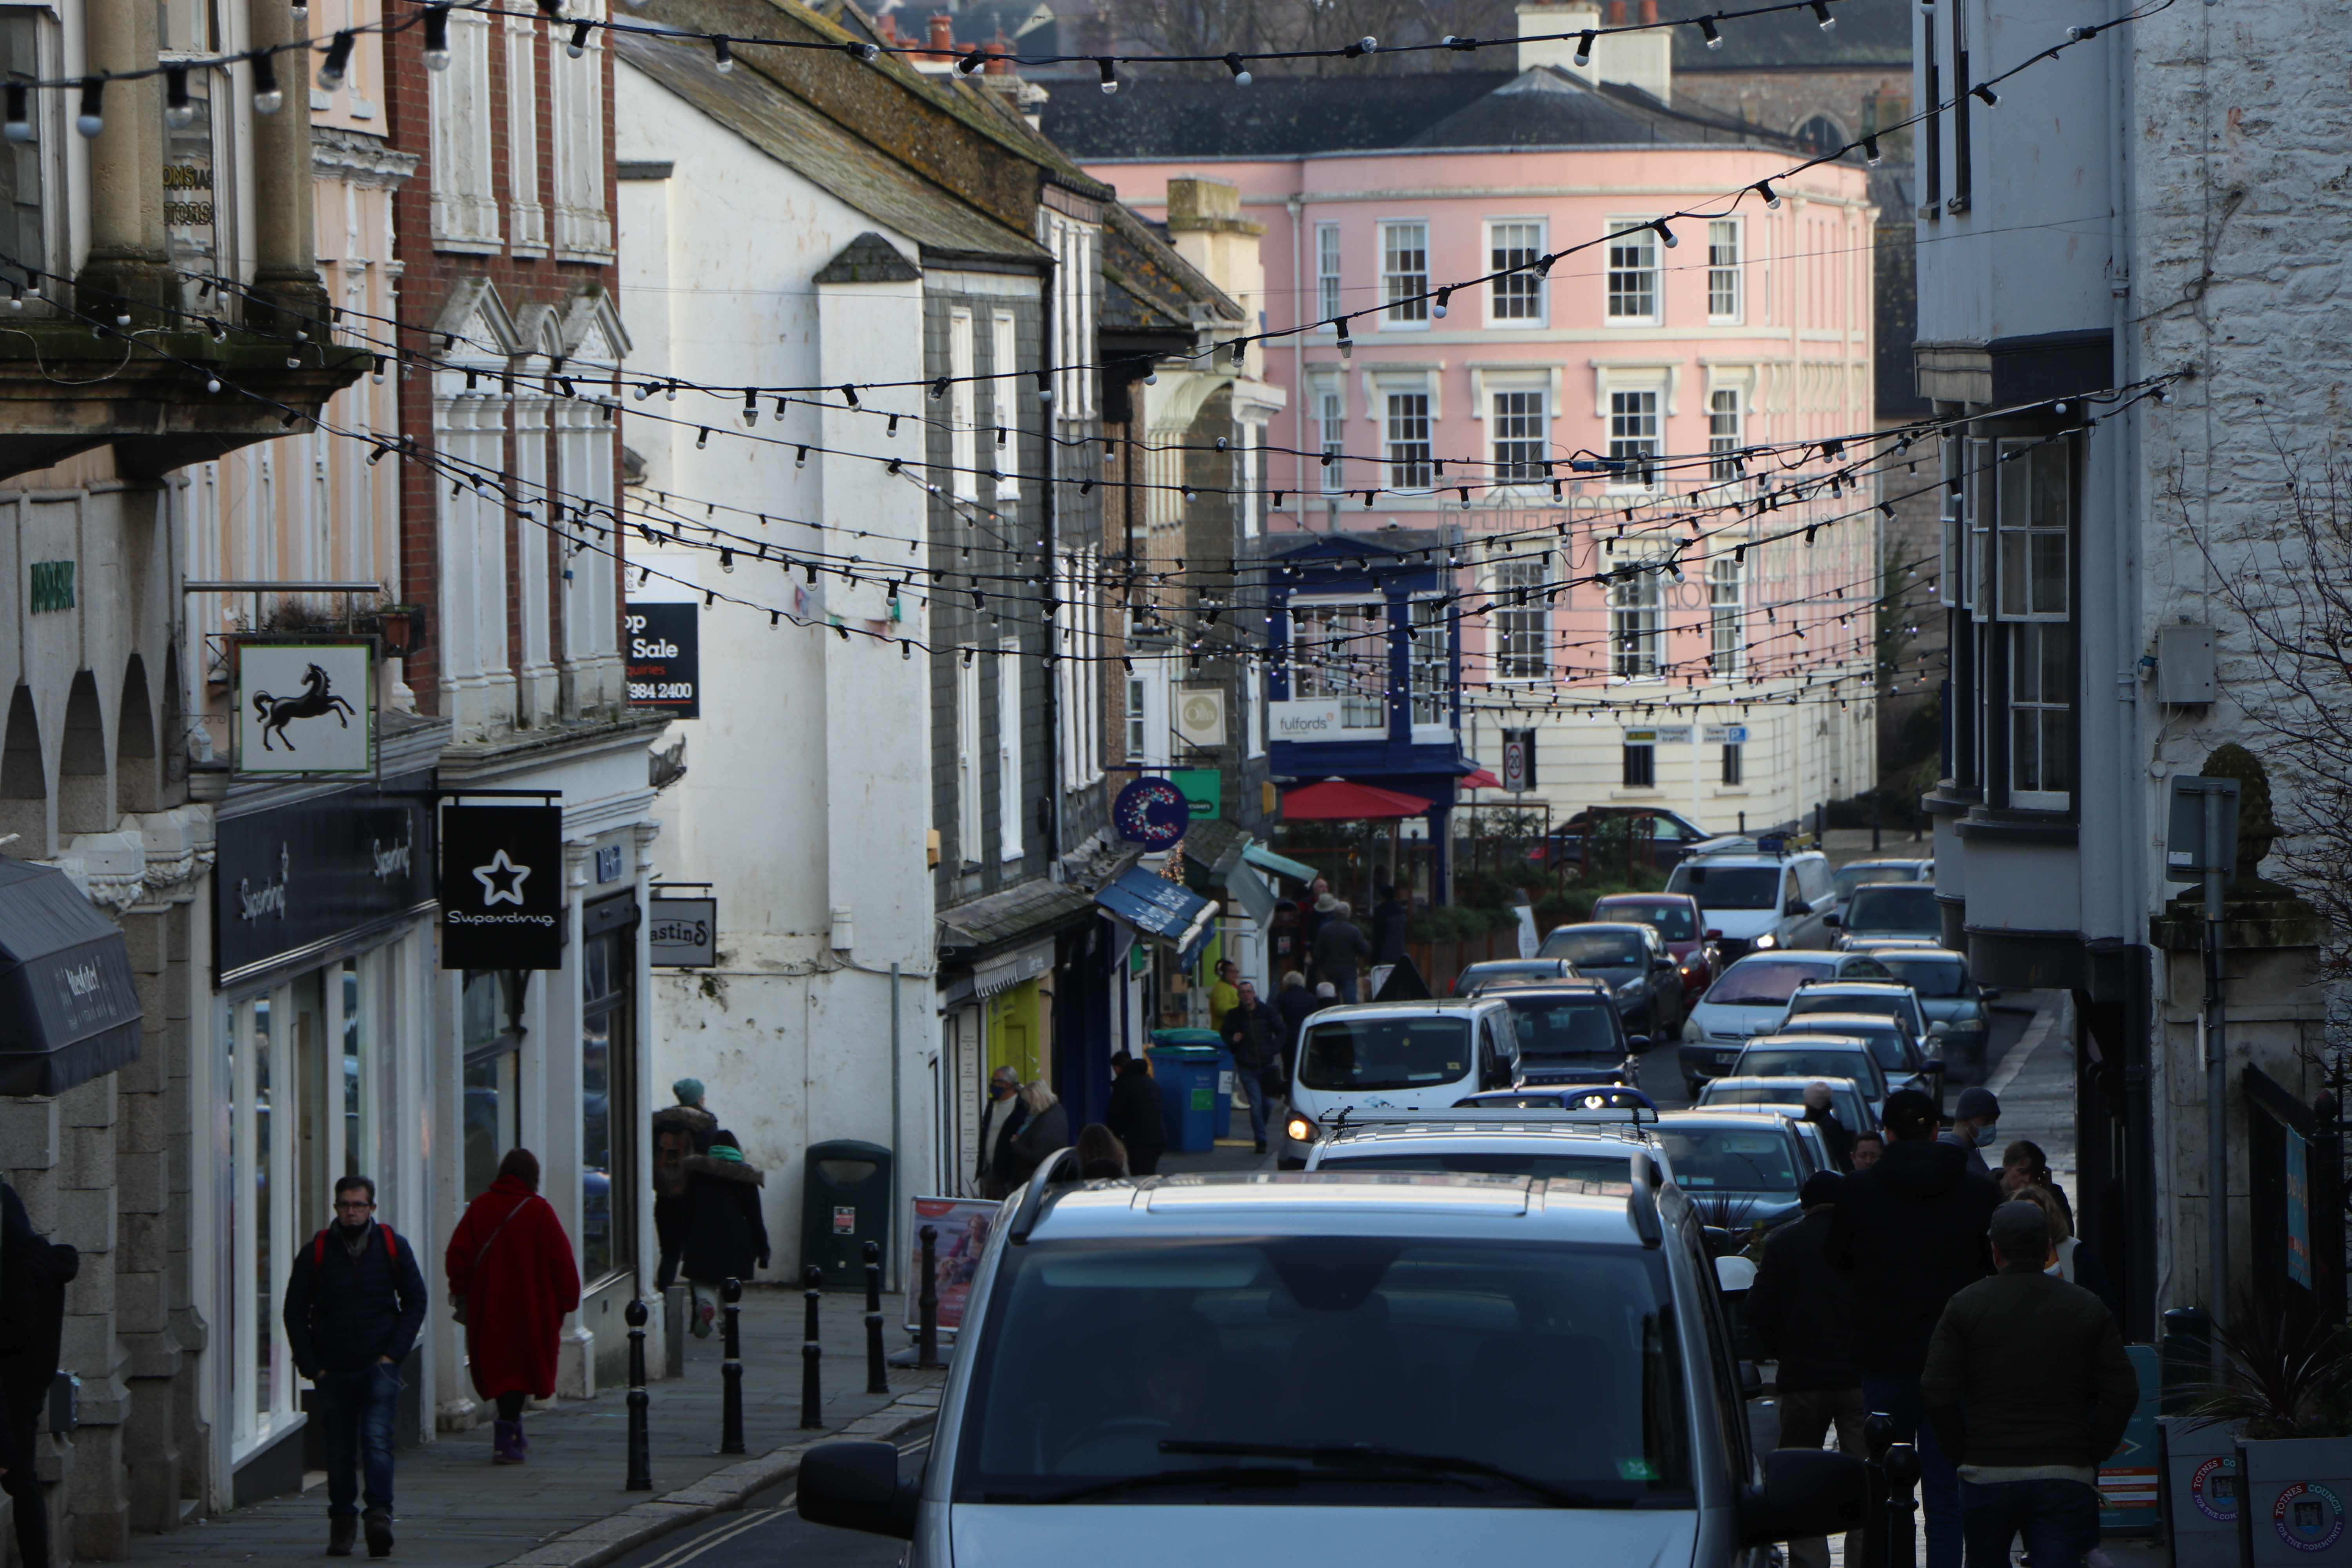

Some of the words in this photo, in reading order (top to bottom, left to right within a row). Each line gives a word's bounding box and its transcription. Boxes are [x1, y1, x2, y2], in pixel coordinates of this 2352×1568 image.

[632, 638, 679, 658] Sale
[626, 664, 666, 677] quiries
[657, 682, 693, 699] 2400
[1280, 716, 1327, 730] fulfords
[1659, 728, 1688, 737] Through
[1731, 729, 1740, 740] P
[1510, 755, 1519, 769] 20
[374, 838, 410, 885] Superdrug
[241, 877, 285, 928] Superdrug
[448, 910, 556, 926] Superdrug
[2194, 1460, 2218, 1488] TOTNES
[2195, 1495, 2205, 1508] FOR
[2205, 1506, 2218, 1519] THE
[2275, 1485, 2302, 1515] TOTNES
[2308, 1484, 2343, 1514] COUNCIL
[2276, 1523, 2287, 1538] FOR
[2287, 1535, 2301, 1548] THE
[2303, 1521, 2342, 1550] COMMUNITY
